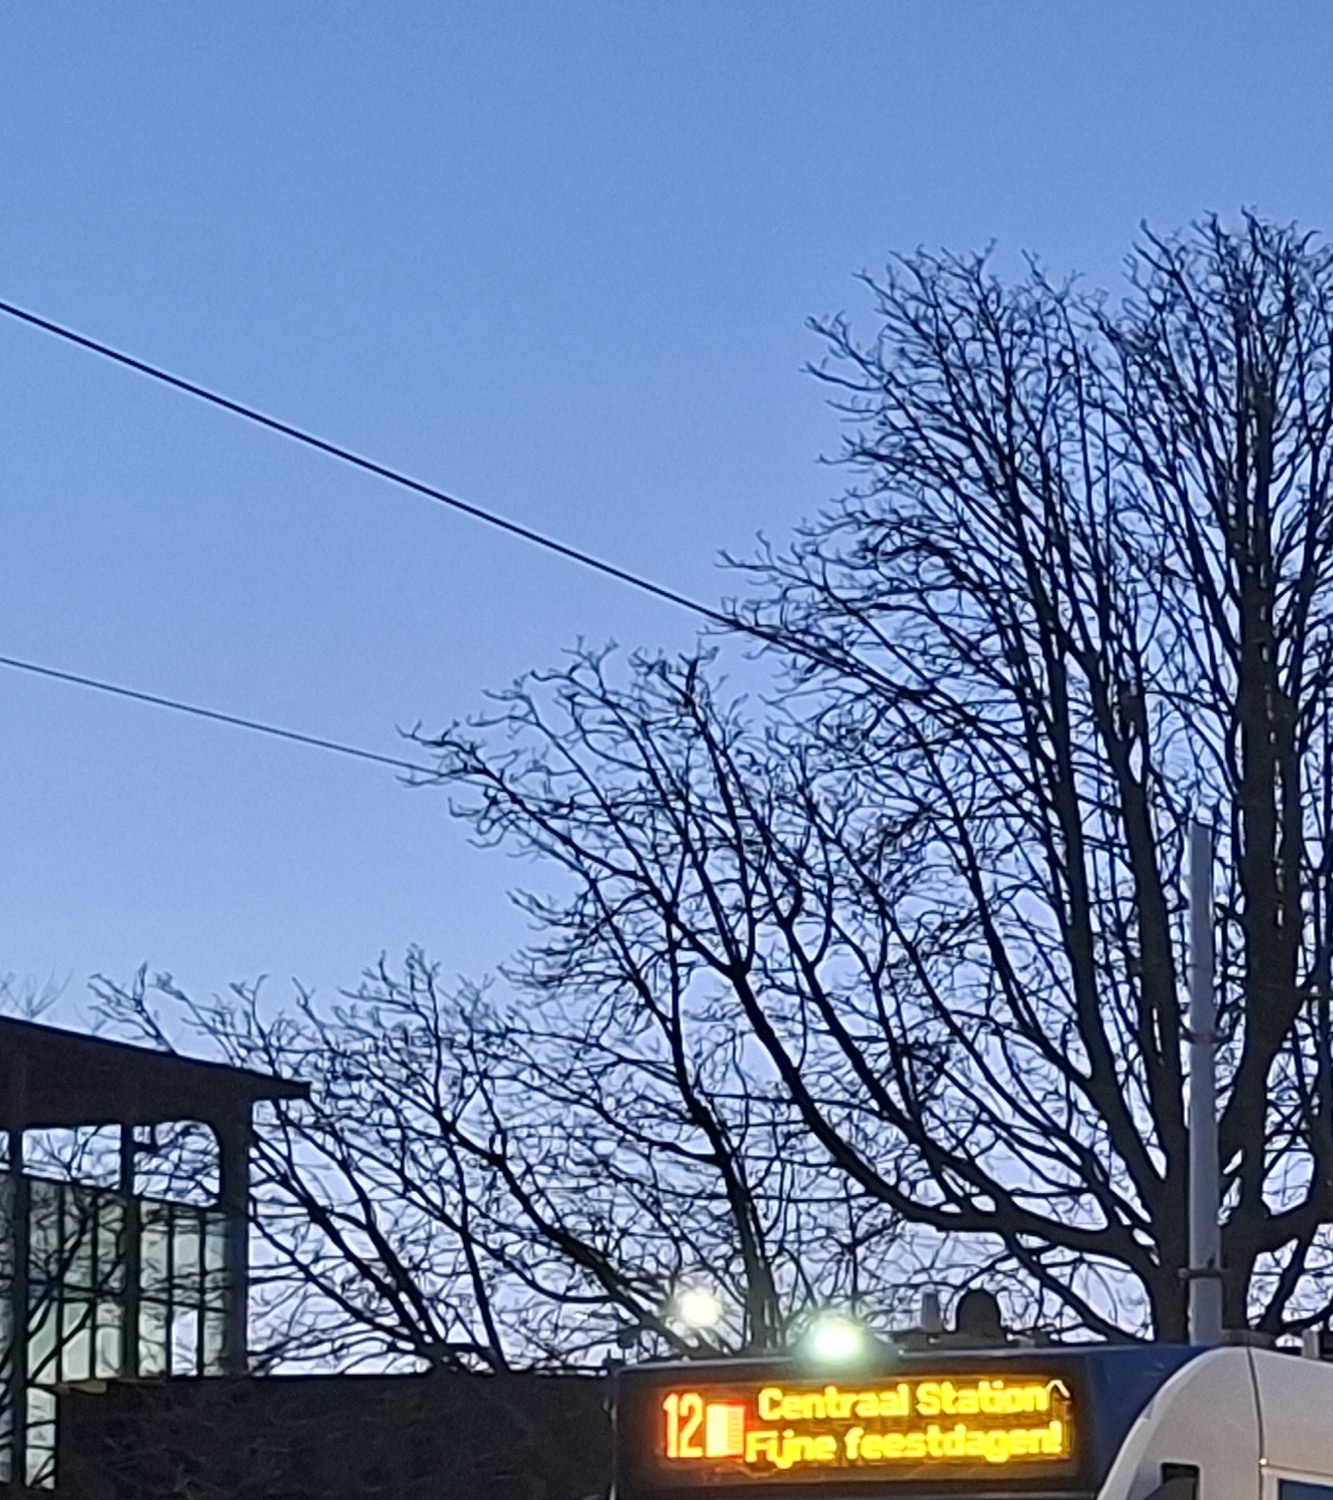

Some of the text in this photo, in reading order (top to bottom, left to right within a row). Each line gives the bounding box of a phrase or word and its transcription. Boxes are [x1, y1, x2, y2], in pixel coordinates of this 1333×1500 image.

[663, 1380, 1049, 1458] 12 Centraal Station
[745, 1420, 1063, 1469] Fijne feestdagen!
